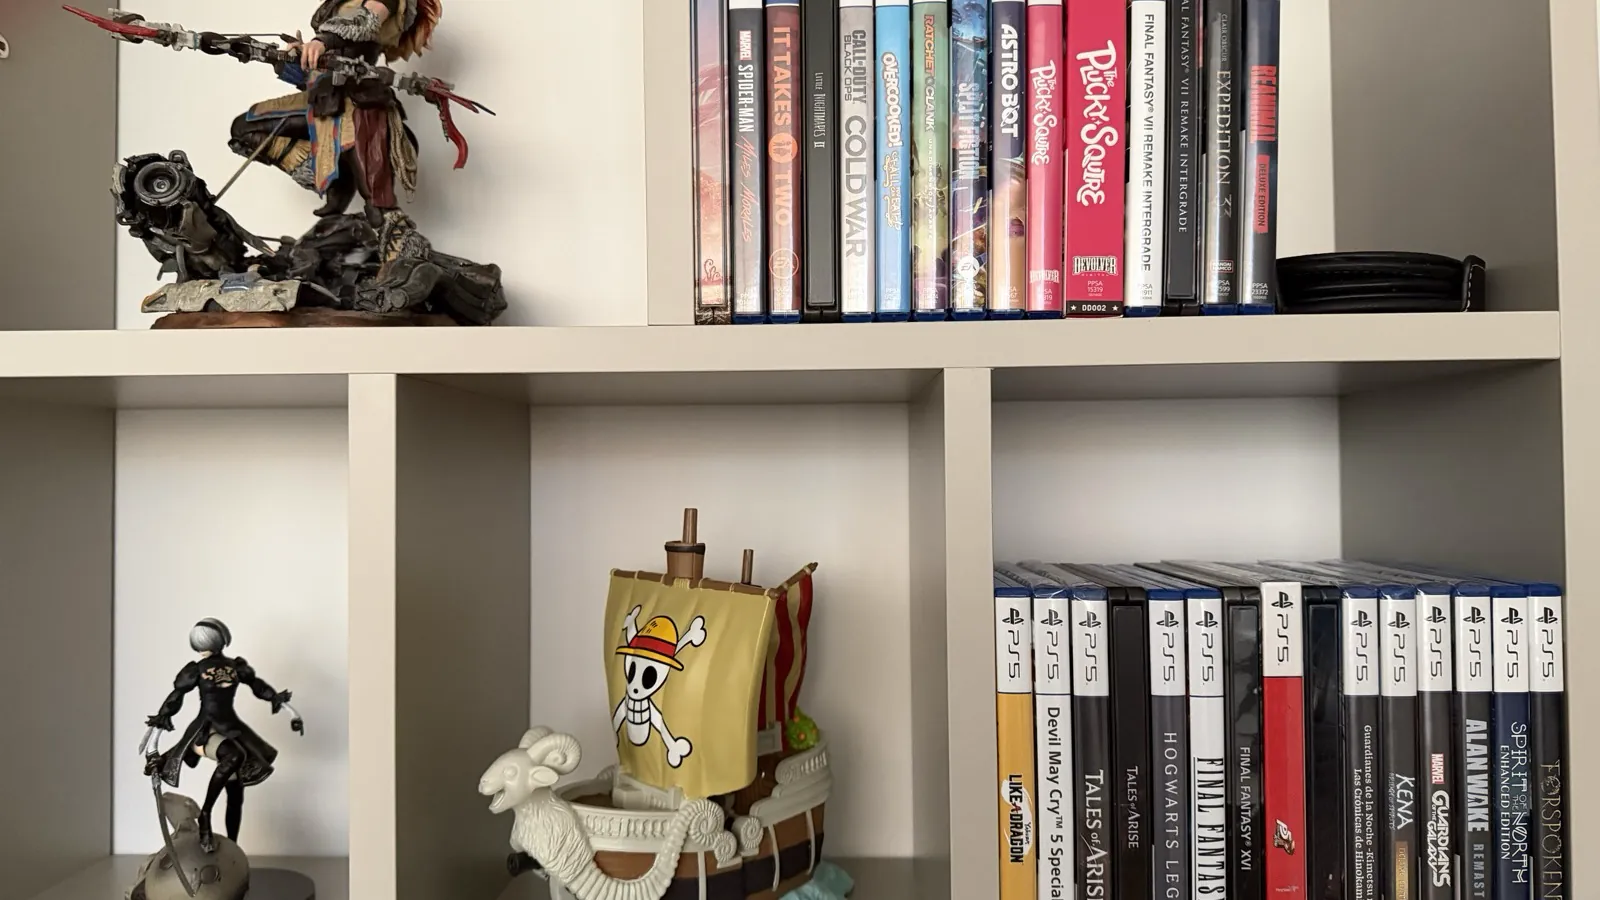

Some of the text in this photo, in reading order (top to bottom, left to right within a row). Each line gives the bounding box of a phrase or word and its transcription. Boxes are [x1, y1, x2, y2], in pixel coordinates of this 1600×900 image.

[739, 31, 752, 60] MARVEL
[852, 30, 867, 63] CALL
[924, 14, 936, 76] RATCHET
[1144, 14, 1155, 48] FINAL
[844, 35, 852, 101] BLACK OPS
[852, 66, 867, 104] DUTY
[1000, 24, 1021, 138] ASTRO BOT
[1180, 79, 1189, 95] VII
[738, 64, 755, 132] SPIDER-MAN
[881, 51, 903, 148] OVERCOOKED!
[925, 86, 935, 131] CLANK
[1250, 65, 1277, 144] REANIMAL
[773, 26, 792, 226] IT TAKES TWO
[958, 83, 980, 180] SPLIT FICTION
[1144, 117, 1154, 131] VII
[1180, 100, 1189, 148] REMAKE
[1216, 70, 1232, 184] EXPEDITION
[1143, 135, 1154, 187] REMAKE
[844, 115, 867, 258] COLD WAR
[1179, 154, 1188, 233] INTERGRADE
[1215, 193, 1232, 219] 33
[1258, 163, 1267, 226] DELUXE EDITION
[1141, 190, 1153, 271] INTERGRADE
[1072, 256, 1118, 276] DEVOLVER
[1008, 628, 1021, 679] PS5
[1047, 630, 1060, 680] PS5
[1085, 632, 1099, 682] PS5
[1162, 632, 1175, 681] PS5
[1202, 632, 1215, 681] PS5
[1277, 614, 1288, 663] PS5
[1357, 632, 1370, 681] PS5
[1393, 633, 1407, 682] PS5
[1429, 628, 1442, 678] PS5
[1469, 629, 1482, 678] PS5
[1507, 629, 1520, 678] PS5
[1542, 629, 1555, 678] PS5
[1047, 707, 1061, 746] Devil
[1045, 750, 1062, 785] May
[1240, 746, 1251, 782] FINAL
[1364, 725, 1374, 783] Guardianes
[1431, 753, 1445, 784] MARVEL
[1466, 718, 1489, 832] ALAN WAKE
[1511, 721, 1528, 791] SPIRIT
[1085, 769, 1104, 829] TALES
[1127, 766, 1138, 801] TALES
[1163, 733, 1179, 849] HOGWARTS
[1365, 786, 1374, 798] de
[1365, 800, 1375, 811] la
[1395, 773, 1416, 830] KENA
[1500, 745, 1511, 860] ENHANCED EDITION
[1519, 794, 1528, 809] OF
[1009, 774, 1024, 864] LIKE A DRAGON
[1051, 834, 1063, 842] 5
[1127, 809, 1141, 849] ARISE
[1197, 757, 1226, 900] FINAL FANTAS
[1353, 769, 1365, 900] Las Crónicas de Hinokam
[1365, 813, 1375, 845] Noche
[1432, 790, 1451, 888] GUARDIANS
[1540, 759, 1563, 900] FORSPOKEN
[1240, 849, 1252, 871] XVI
[1427, 820, 1437, 873] GALAXY
[1086, 845, 1108, 900] ARIS
